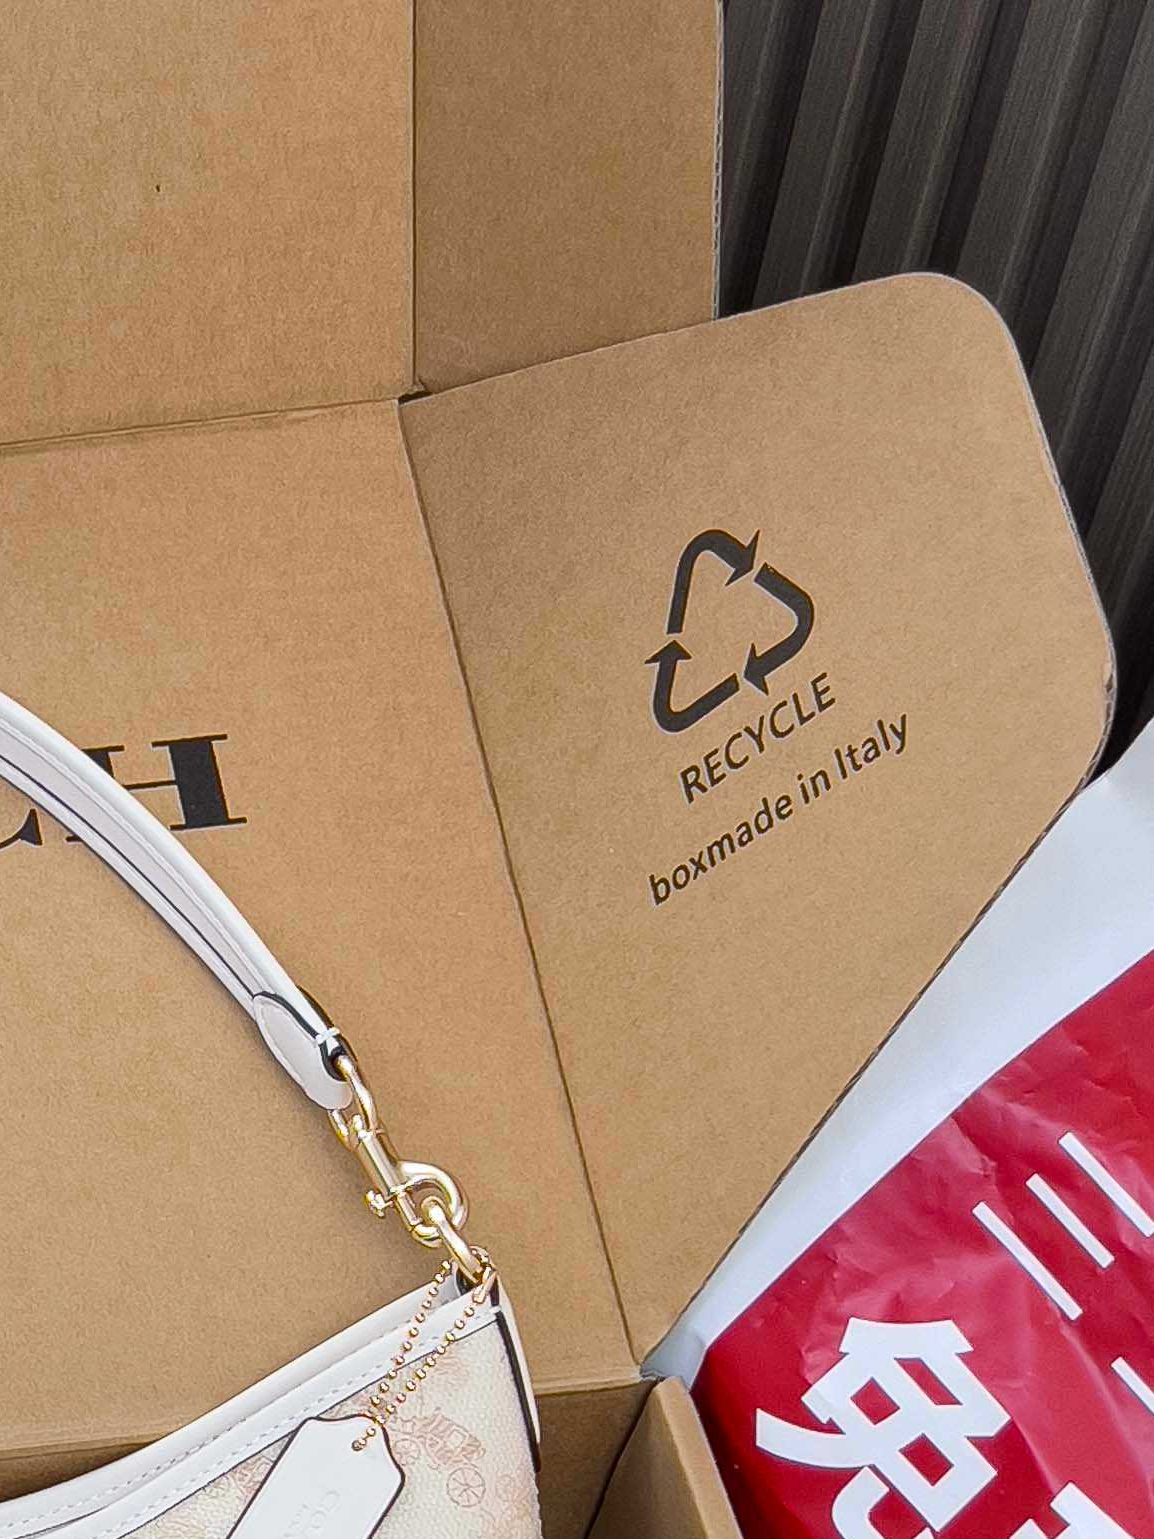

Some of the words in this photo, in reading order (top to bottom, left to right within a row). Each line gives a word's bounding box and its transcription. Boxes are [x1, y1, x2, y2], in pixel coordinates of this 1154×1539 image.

[649, 796, 793, 906] boxmade
[797, 772, 832, 804] in
[834, 713, 908, 781] Italy
[679, 672, 837, 803] RECYCLE
[972, 1131, 1154, 1415] 三
